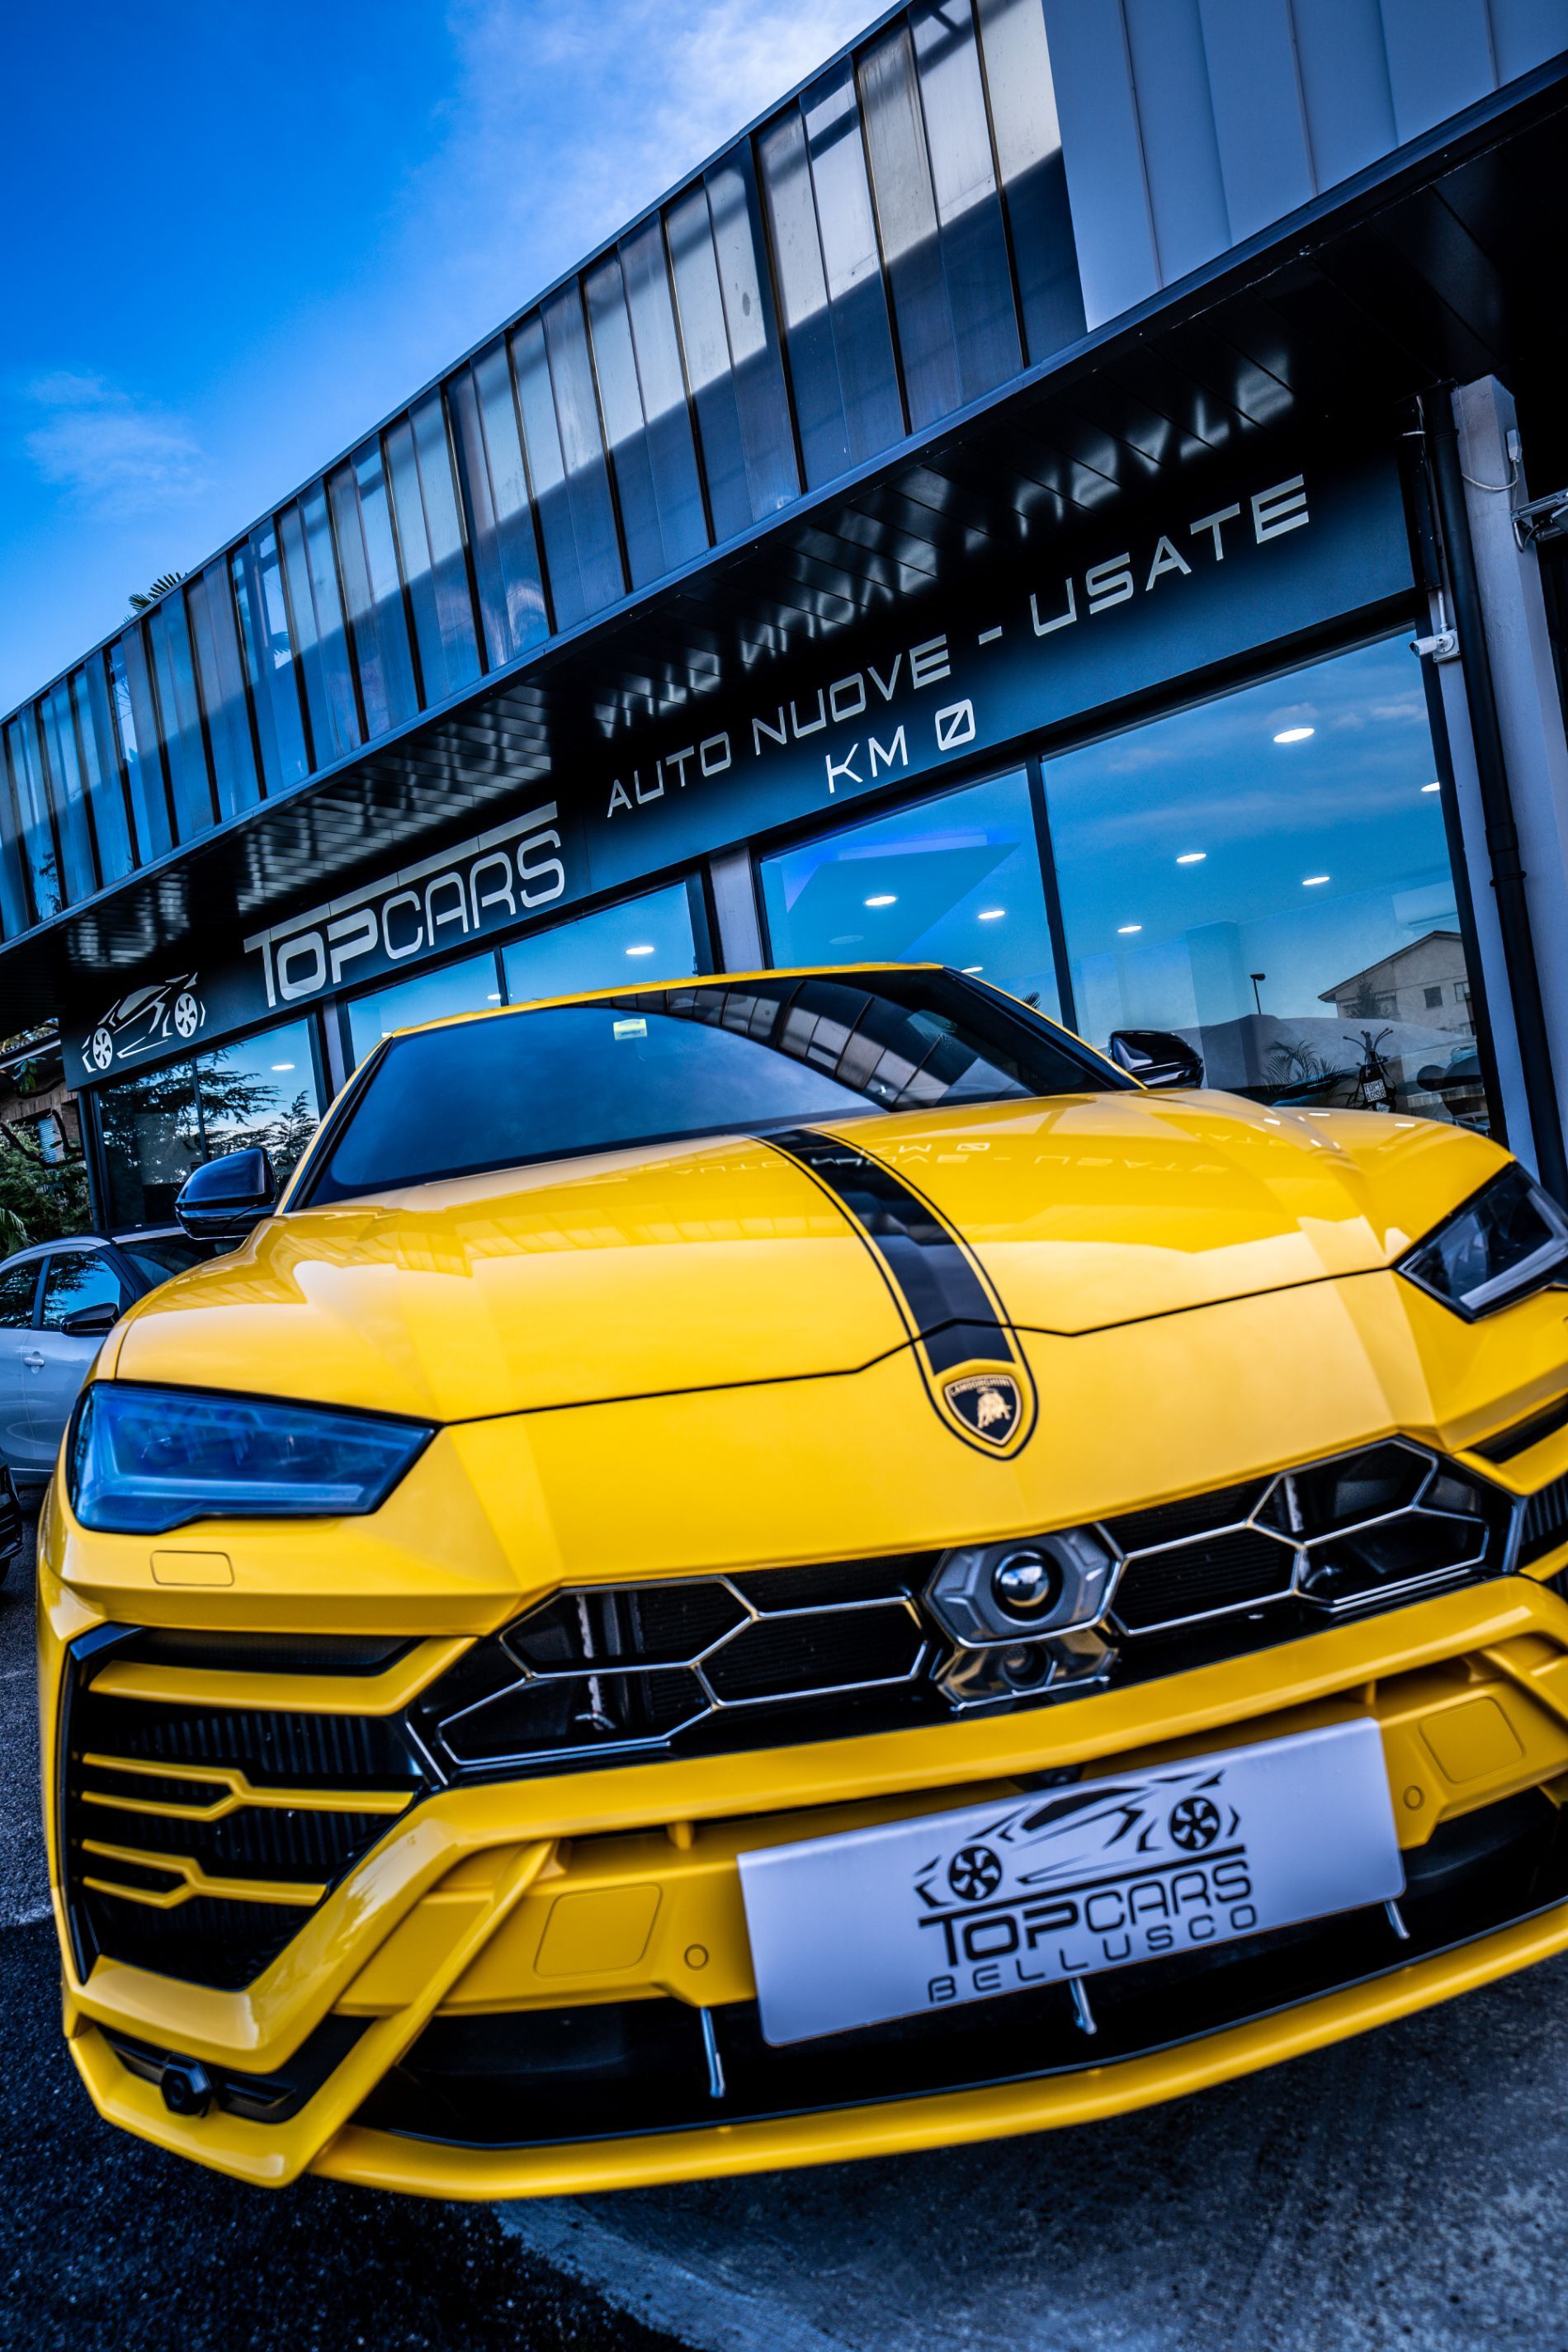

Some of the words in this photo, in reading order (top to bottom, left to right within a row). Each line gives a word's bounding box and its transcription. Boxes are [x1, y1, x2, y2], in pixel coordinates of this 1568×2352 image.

[607, 735, 733, 819] AUTO
[752, 634, 952, 756] NUOVE
[1030, 474, 1311, 637] USATE
[825, 725, 909, 794] KM
[928, 1903, 1257, 2003] BELLUSCO
